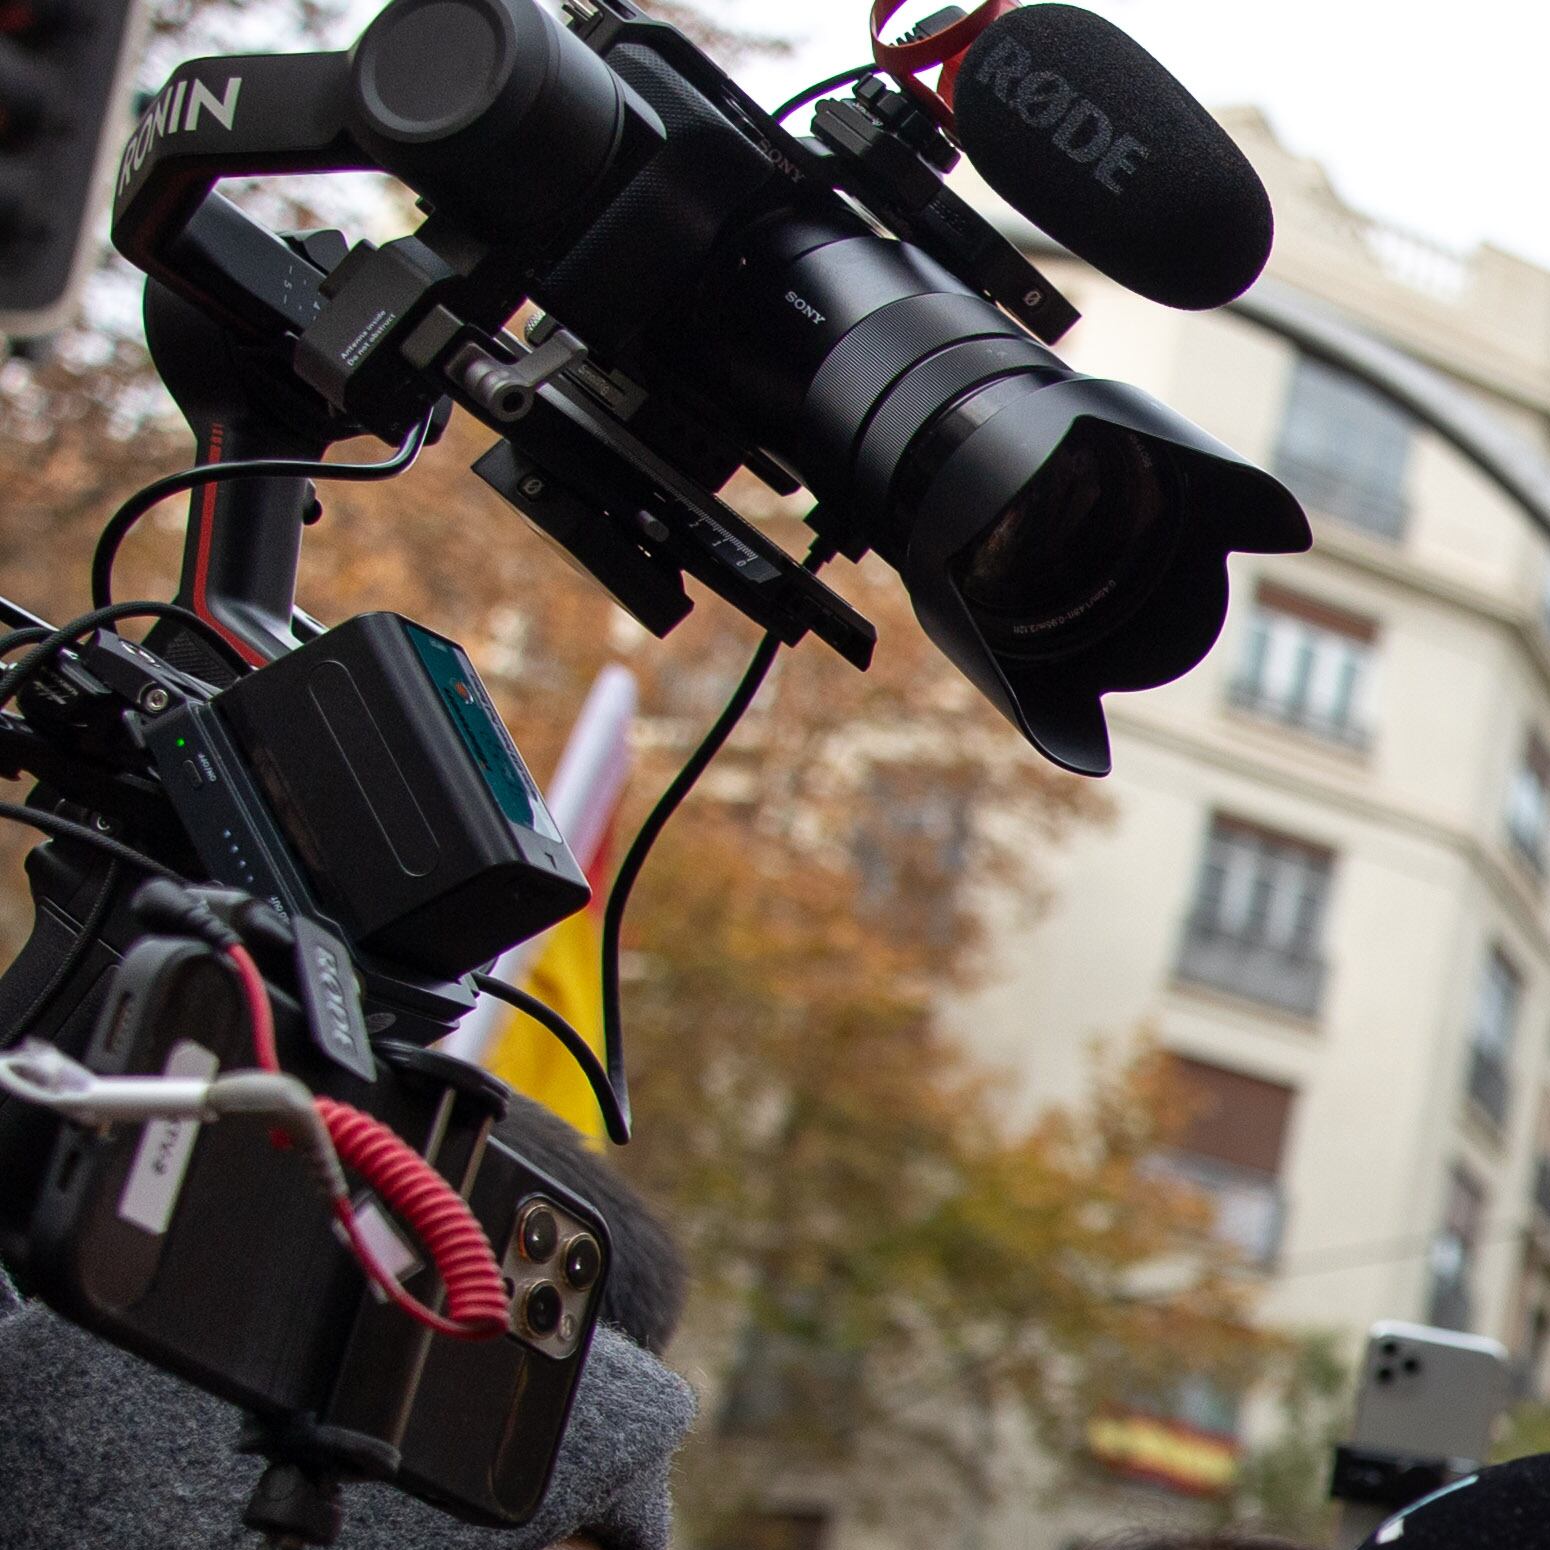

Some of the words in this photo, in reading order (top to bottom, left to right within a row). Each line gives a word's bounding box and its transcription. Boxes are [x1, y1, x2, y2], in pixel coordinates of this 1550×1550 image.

[118, 77, 242, 197] RONIN
[759, 138, 805, 184] SONY
[785, 290, 826, 325] SONY
[340, 331, 368, 360] Antenna
[367, 310, 387, 331] inside
[346, 355, 360, 367] Do
[358, 341, 371, 356] not
[369, 313, 397, 343] obstruct
